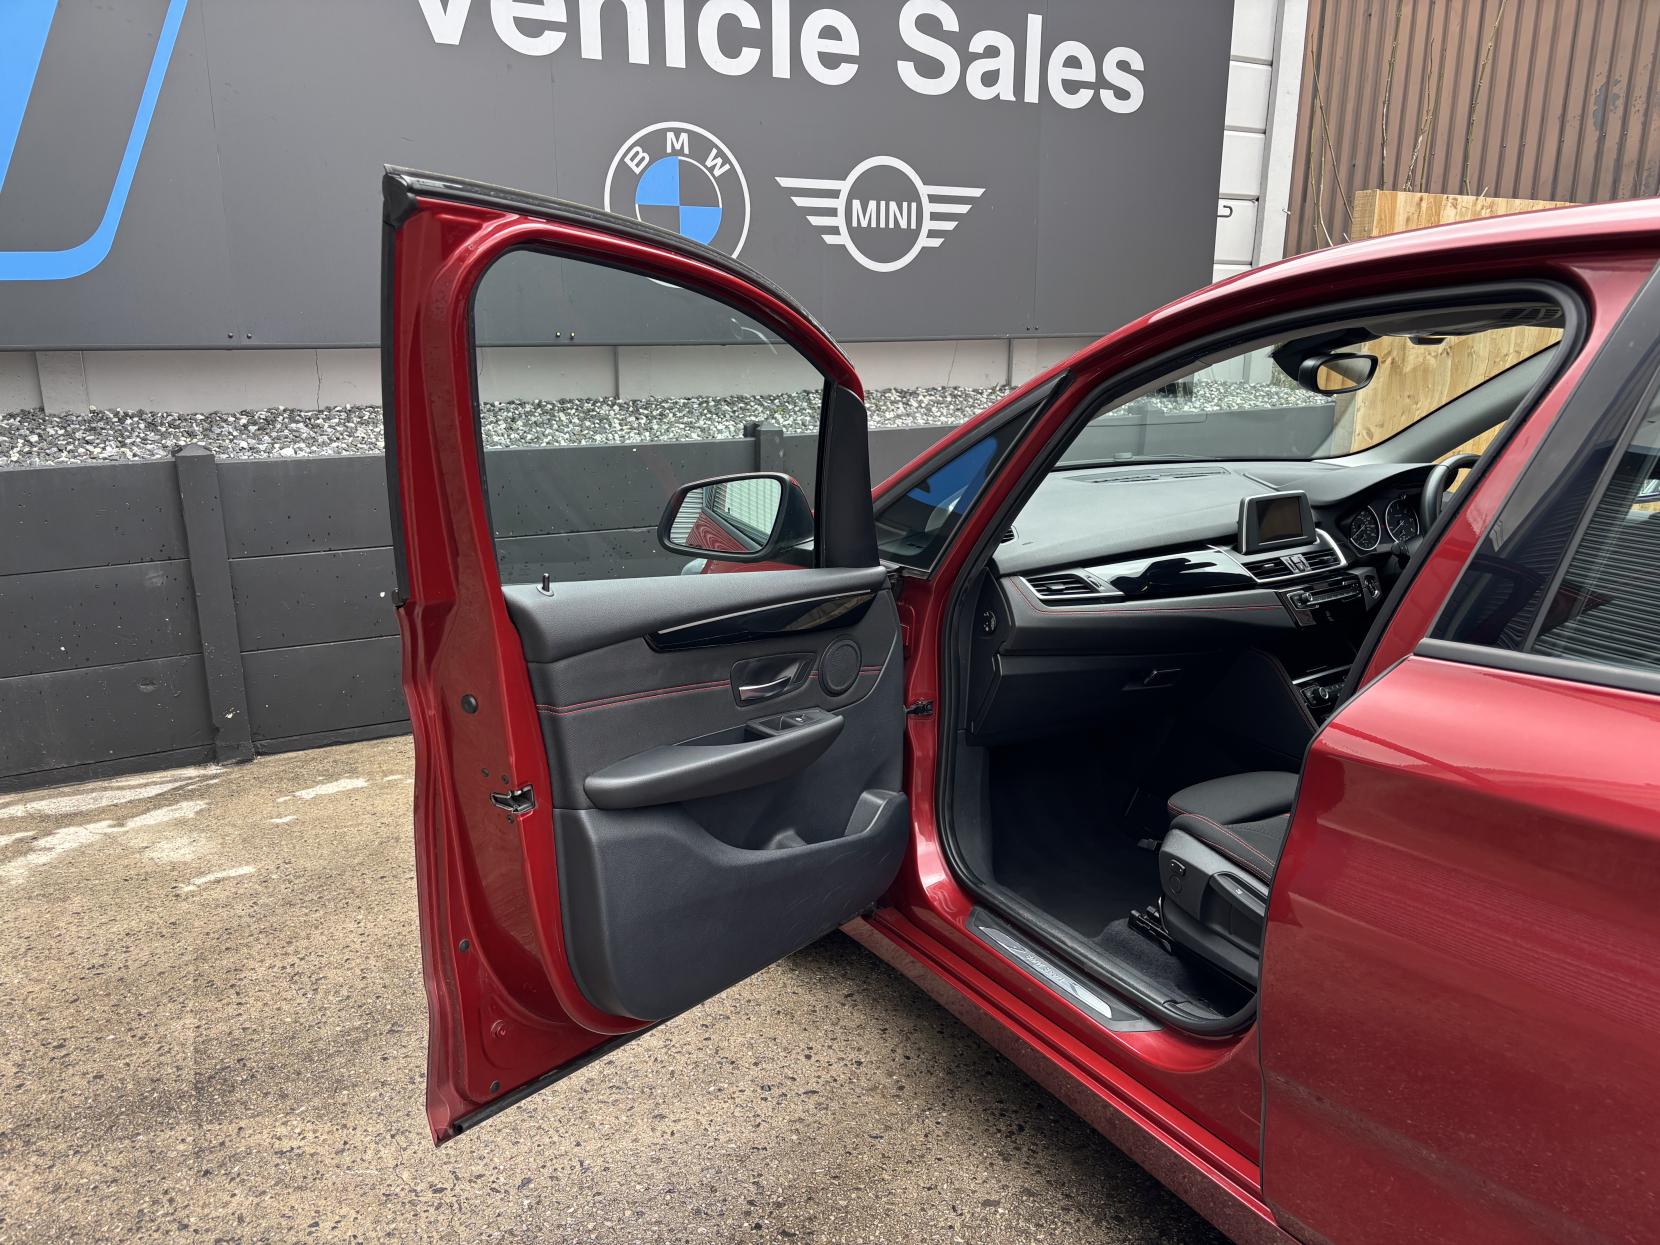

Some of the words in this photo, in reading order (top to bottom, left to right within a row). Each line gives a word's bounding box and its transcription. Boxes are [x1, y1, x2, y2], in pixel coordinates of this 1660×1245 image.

[896, 0, 1145, 114] Sales
[623, 131, 731, 178] BMW
[851, 199, 917, 230] MINI
